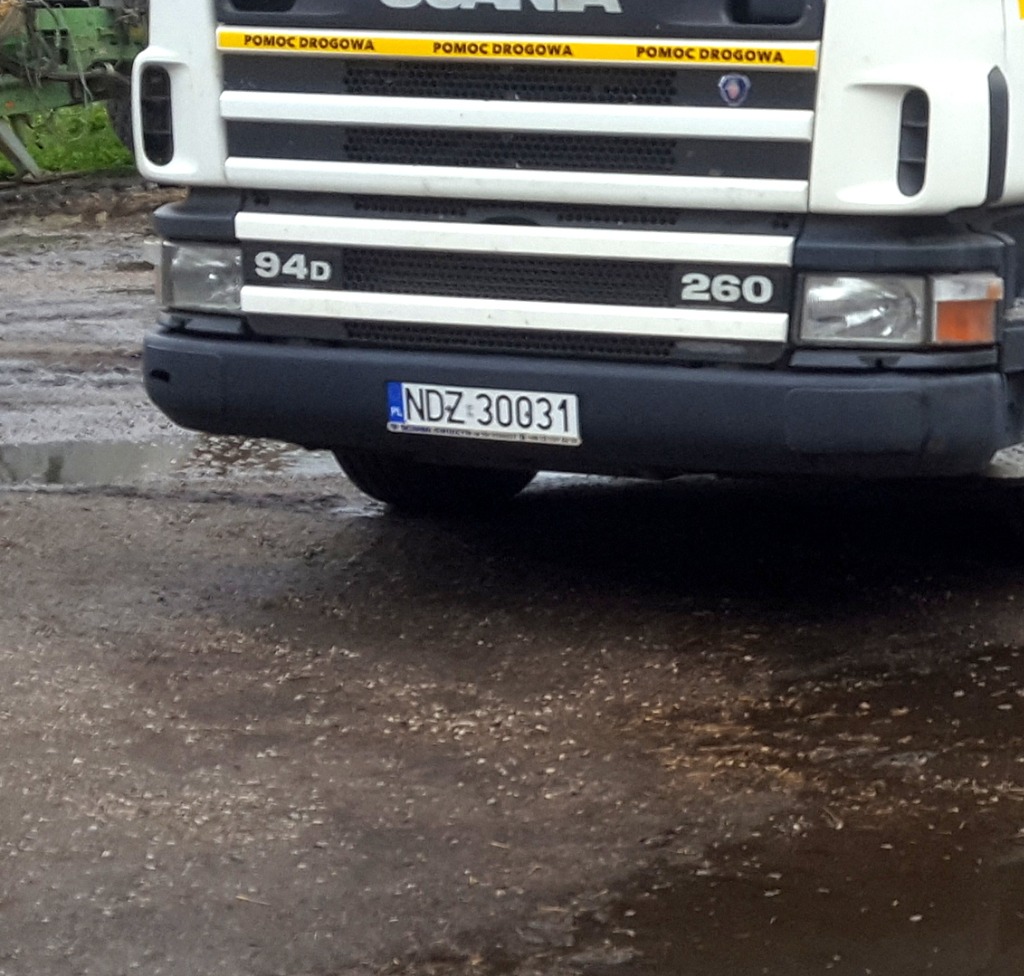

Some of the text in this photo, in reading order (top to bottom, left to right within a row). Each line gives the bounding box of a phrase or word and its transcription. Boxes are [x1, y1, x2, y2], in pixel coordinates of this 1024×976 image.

[244, 34, 375, 51] POMOC DROGOWA
[433, 41, 573, 56] POMOC DROGOWA
[636, 46, 784, 63] POMOC DROGOWA
[254, 251, 332, 282] 94D
[681, 272, 774, 304] 260
